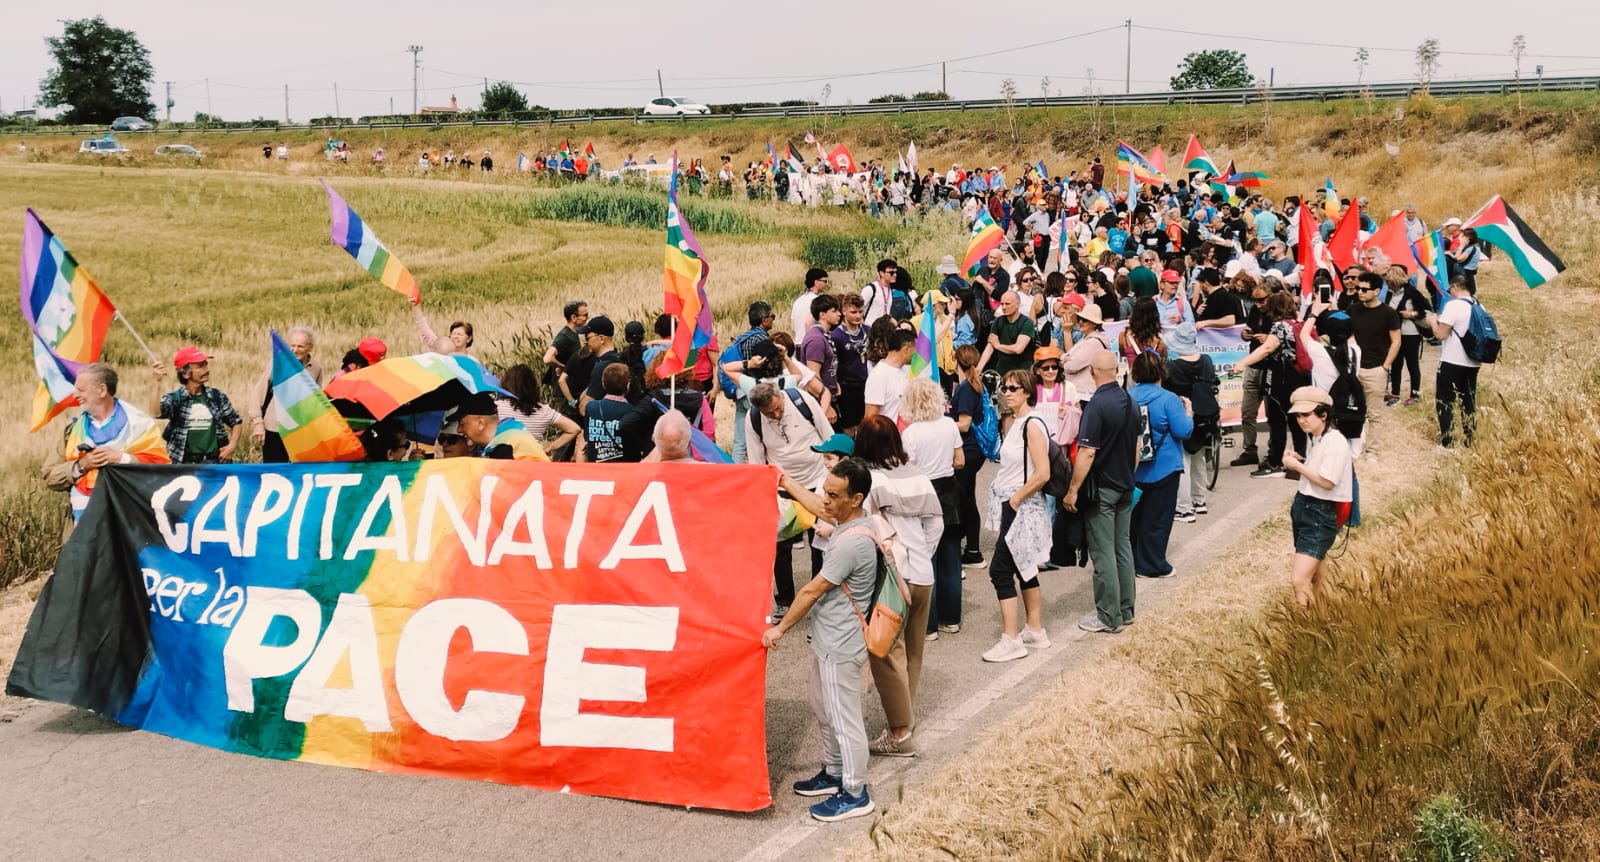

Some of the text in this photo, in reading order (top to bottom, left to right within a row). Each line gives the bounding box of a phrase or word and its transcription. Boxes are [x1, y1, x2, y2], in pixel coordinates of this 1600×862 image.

[151, 473, 687, 573] CAPITANATA
[196, 567, 244, 628] la
[223, 586, 680, 752] PACE
